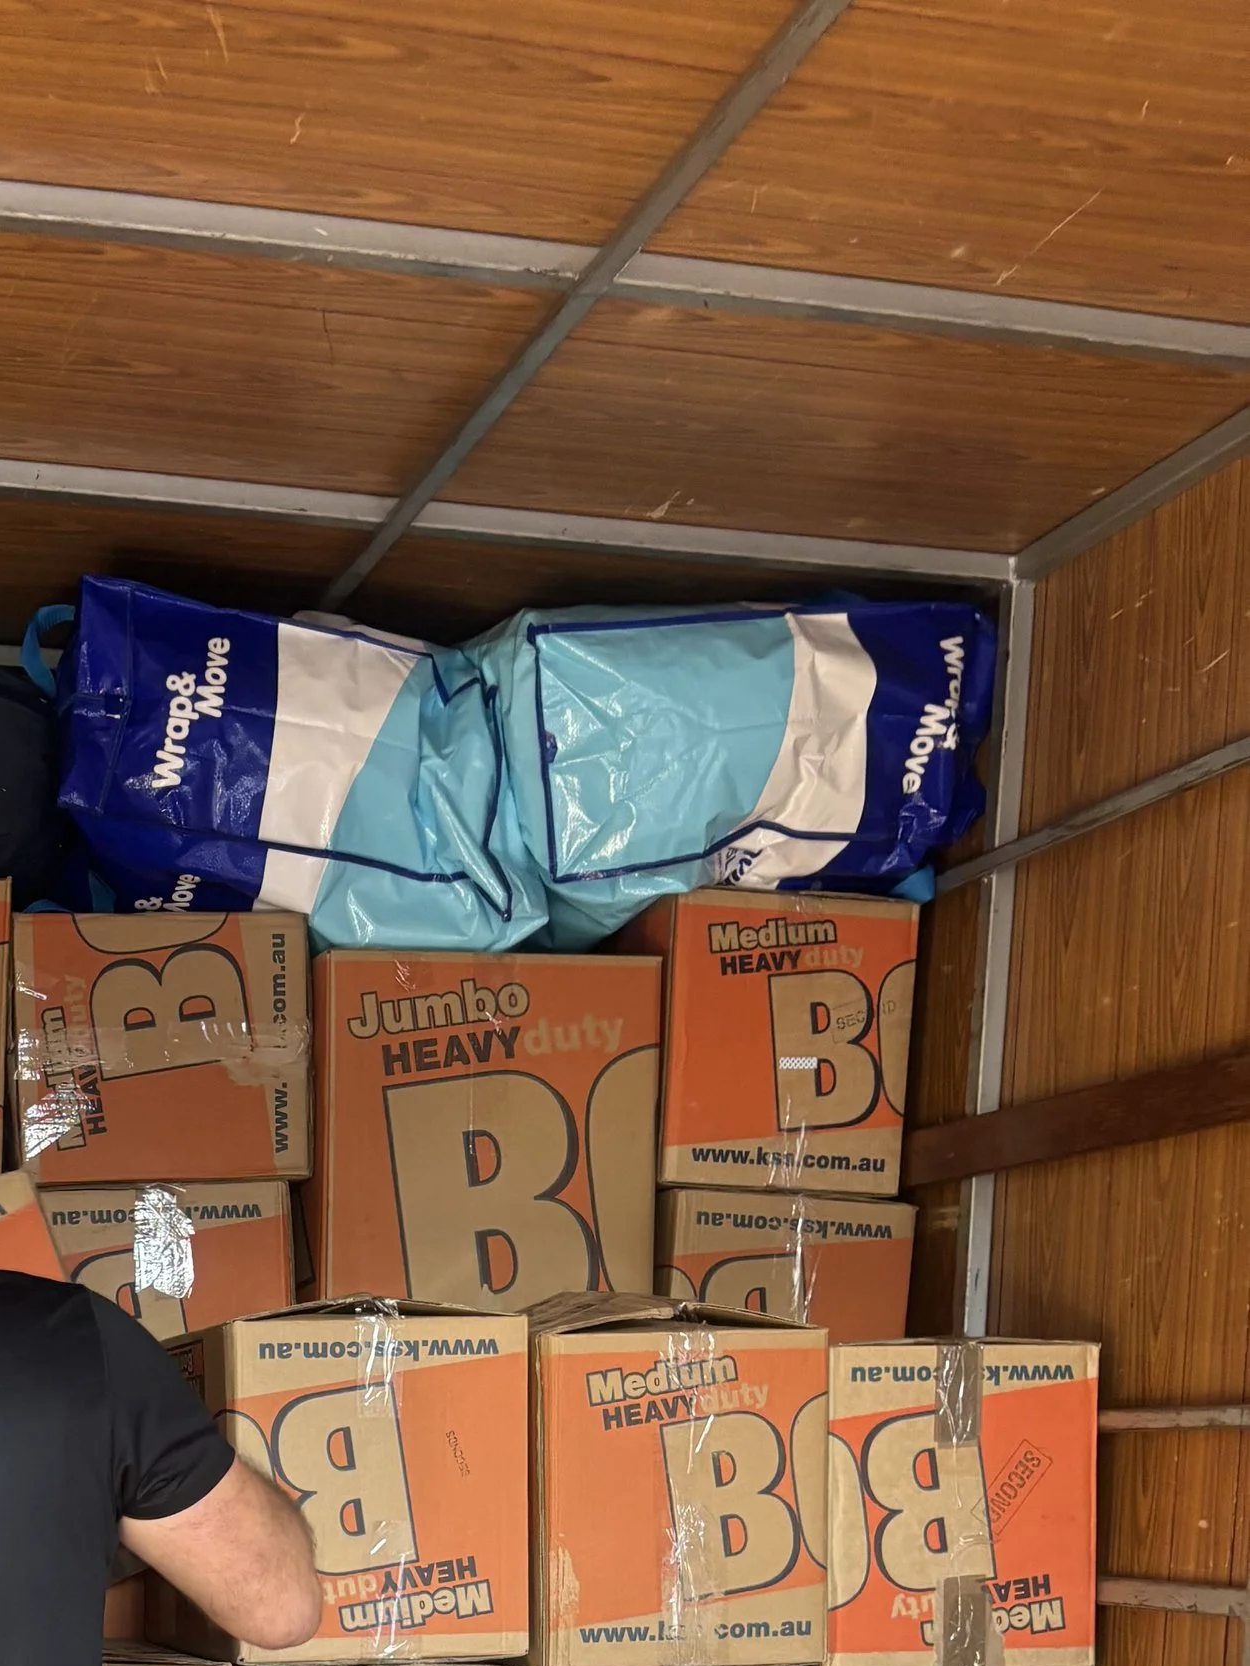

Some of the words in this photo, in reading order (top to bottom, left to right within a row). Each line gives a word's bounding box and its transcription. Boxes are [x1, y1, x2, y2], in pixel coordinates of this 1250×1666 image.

[194, 636, 230, 718] Move
[902, 701, 950, 794] Move
[707, 917, 838, 954] Medium
[719, 948, 803, 976] HEAVY
[803, 944, 866, 969] duty
[347, 977, 532, 1041] Jumbo
[381, 1024, 521, 1077] HEAVY
[523, 1012, 625, 1057] duty
[585, 1355, 738, 1407] Medium
[602, 1396, 695, 1432] HEAVY
[380, 1555, 478, 1594] HEAVY
[338, 1579, 495, 1633] Medium
